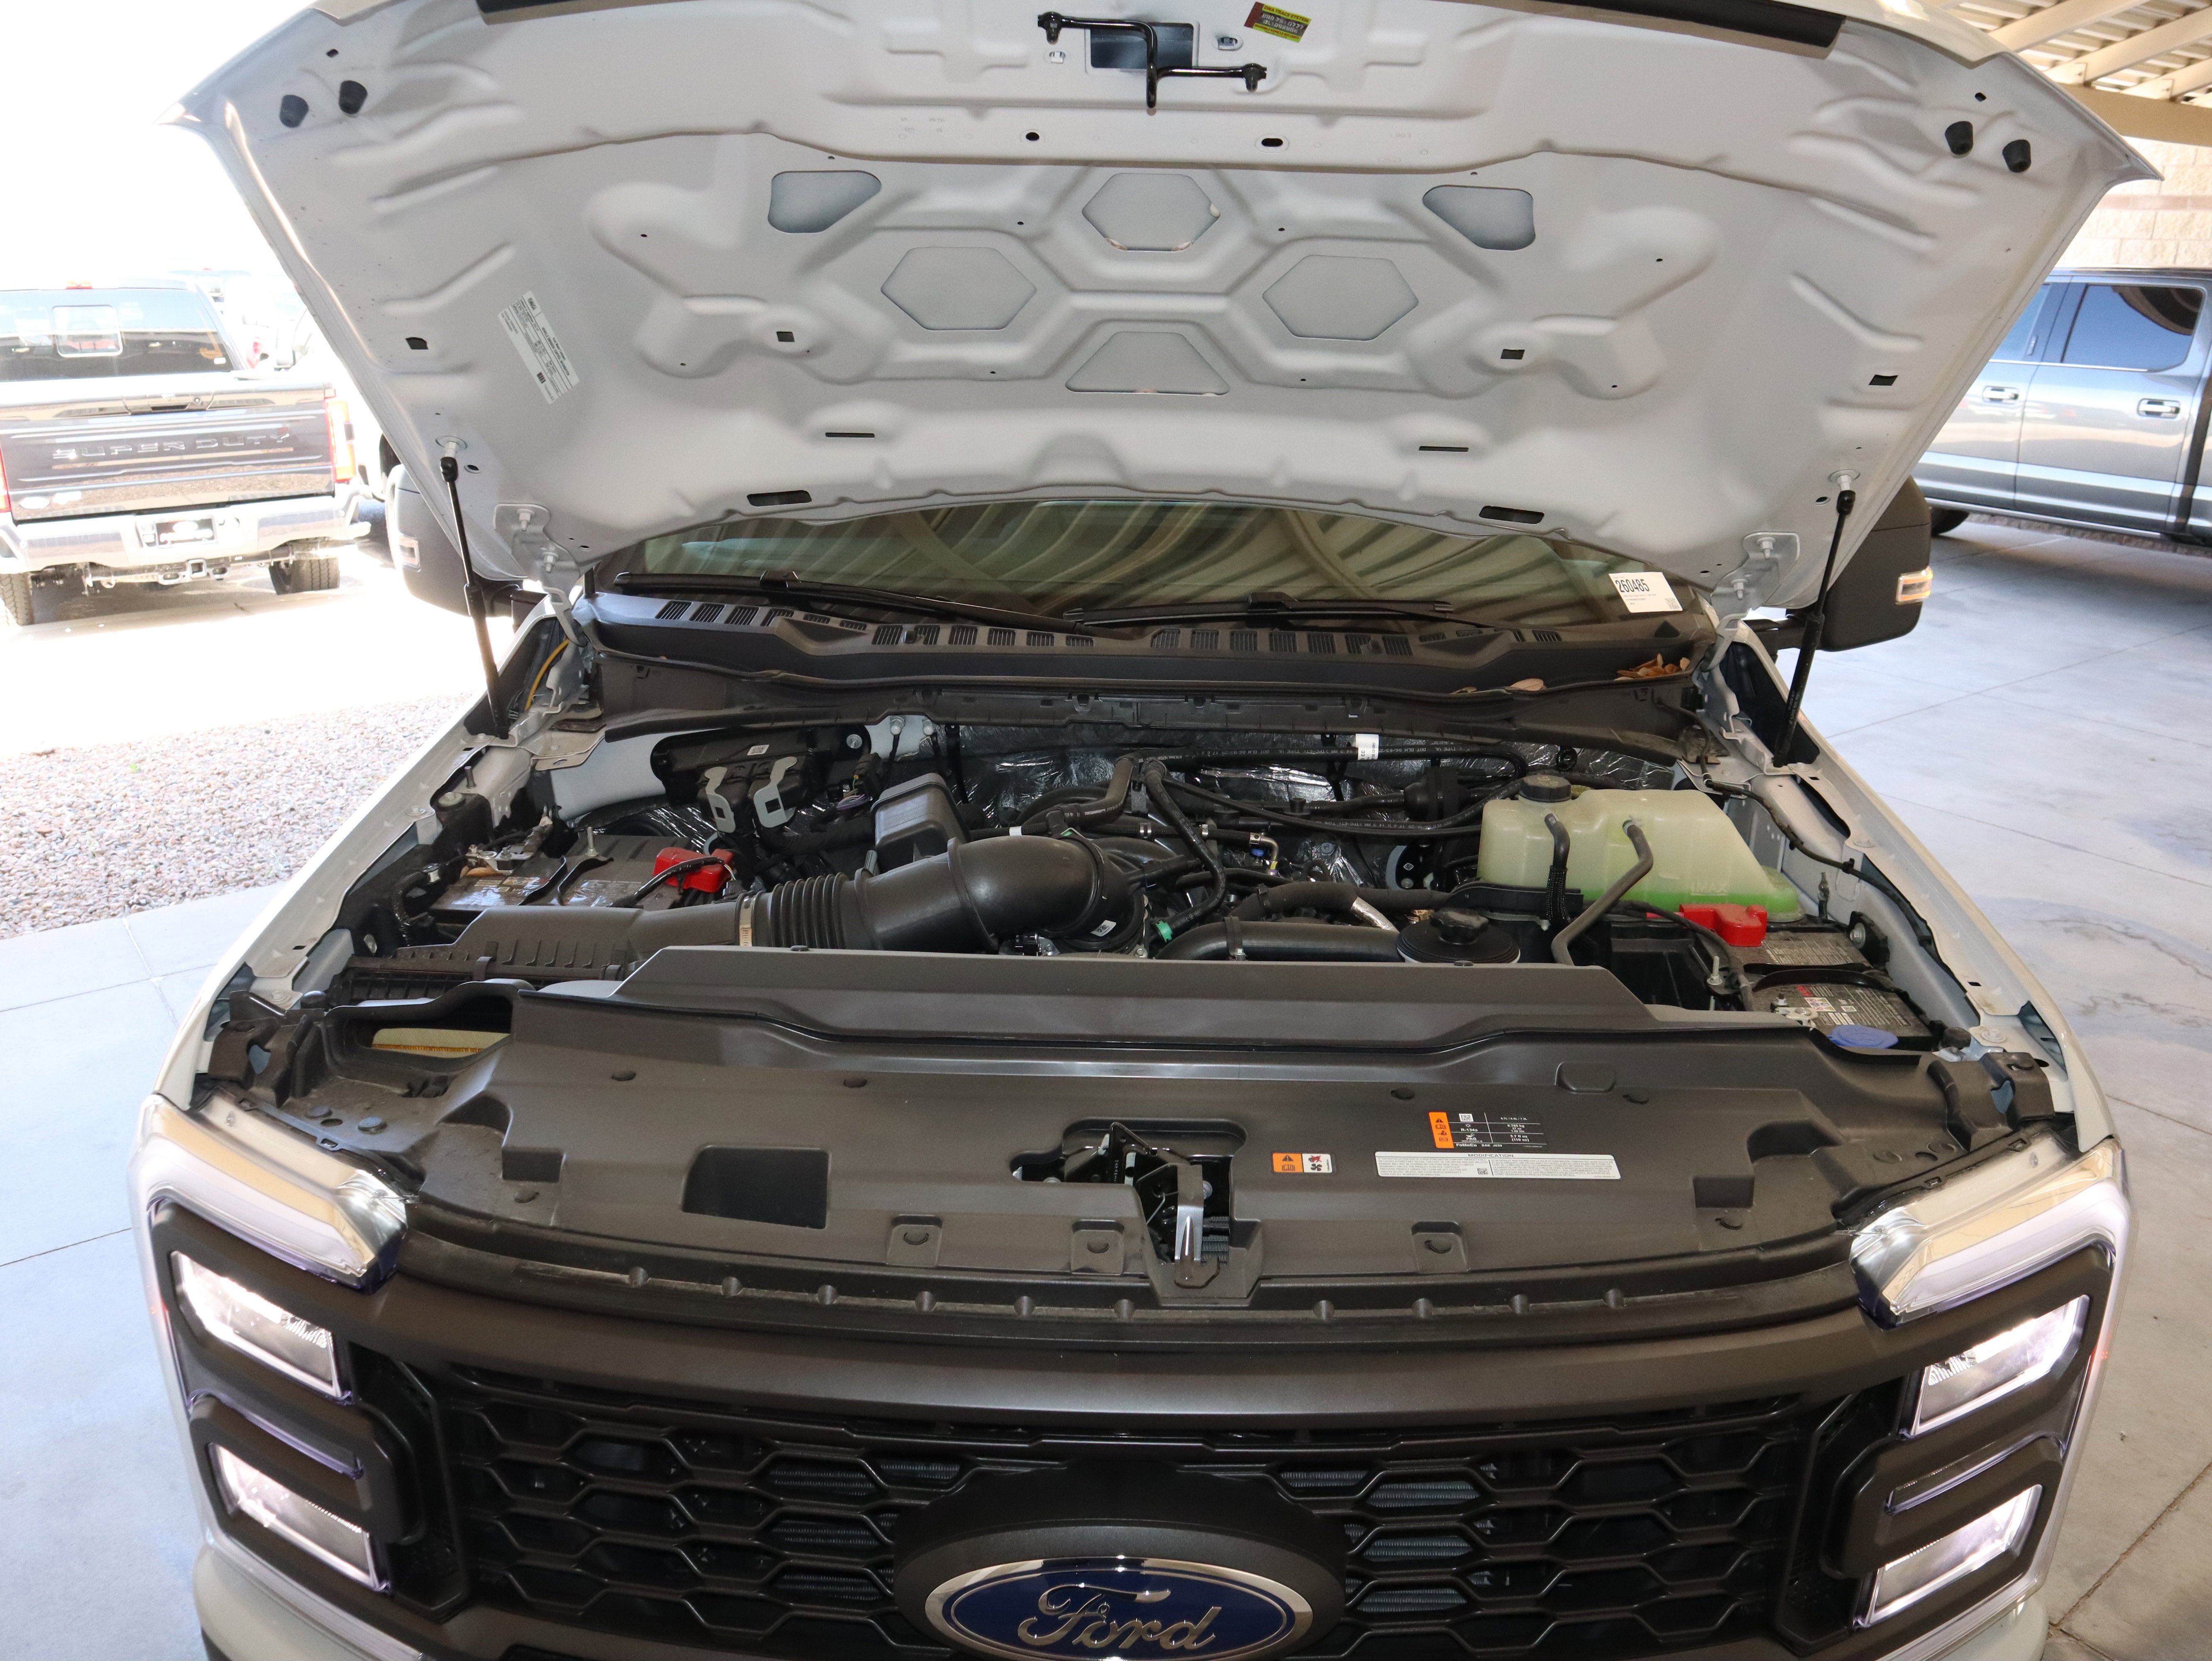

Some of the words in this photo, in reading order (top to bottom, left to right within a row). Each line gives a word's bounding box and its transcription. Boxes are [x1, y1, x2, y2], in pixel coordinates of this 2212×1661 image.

[52, 440, 185, 459] SUPER
[196, 433, 289, 449] DUTY
[1615, 579, 1649, 593] 260485
[1018, 1583, 1221, 1651] Ford
